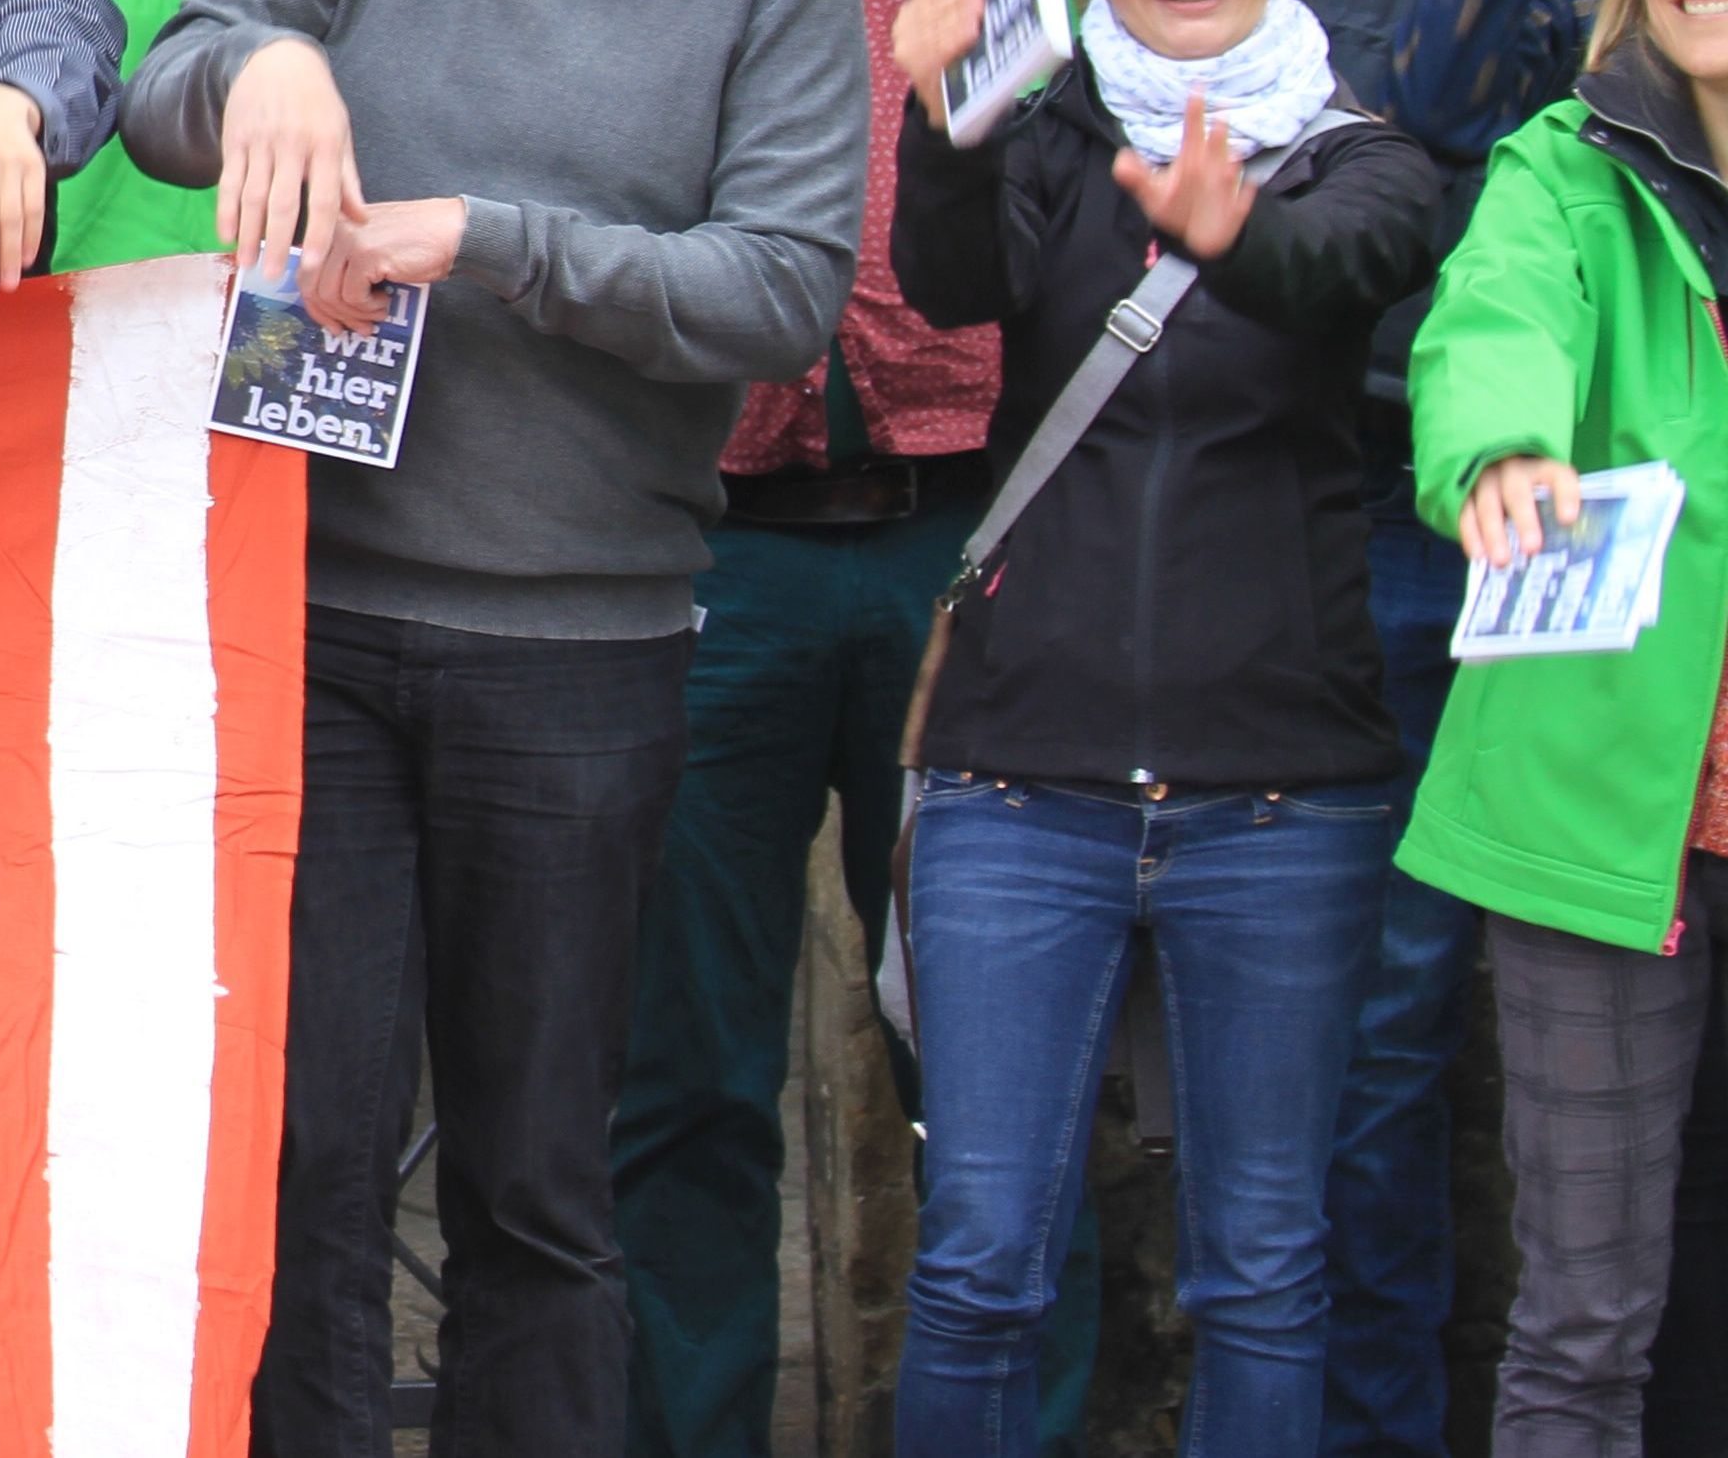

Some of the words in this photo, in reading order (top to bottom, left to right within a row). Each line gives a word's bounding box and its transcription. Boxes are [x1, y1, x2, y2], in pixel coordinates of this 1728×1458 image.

[321, 325, 405, 368] wir
[295, 352, 398, 410] hier
[242, 385, 382, 454] leben.
